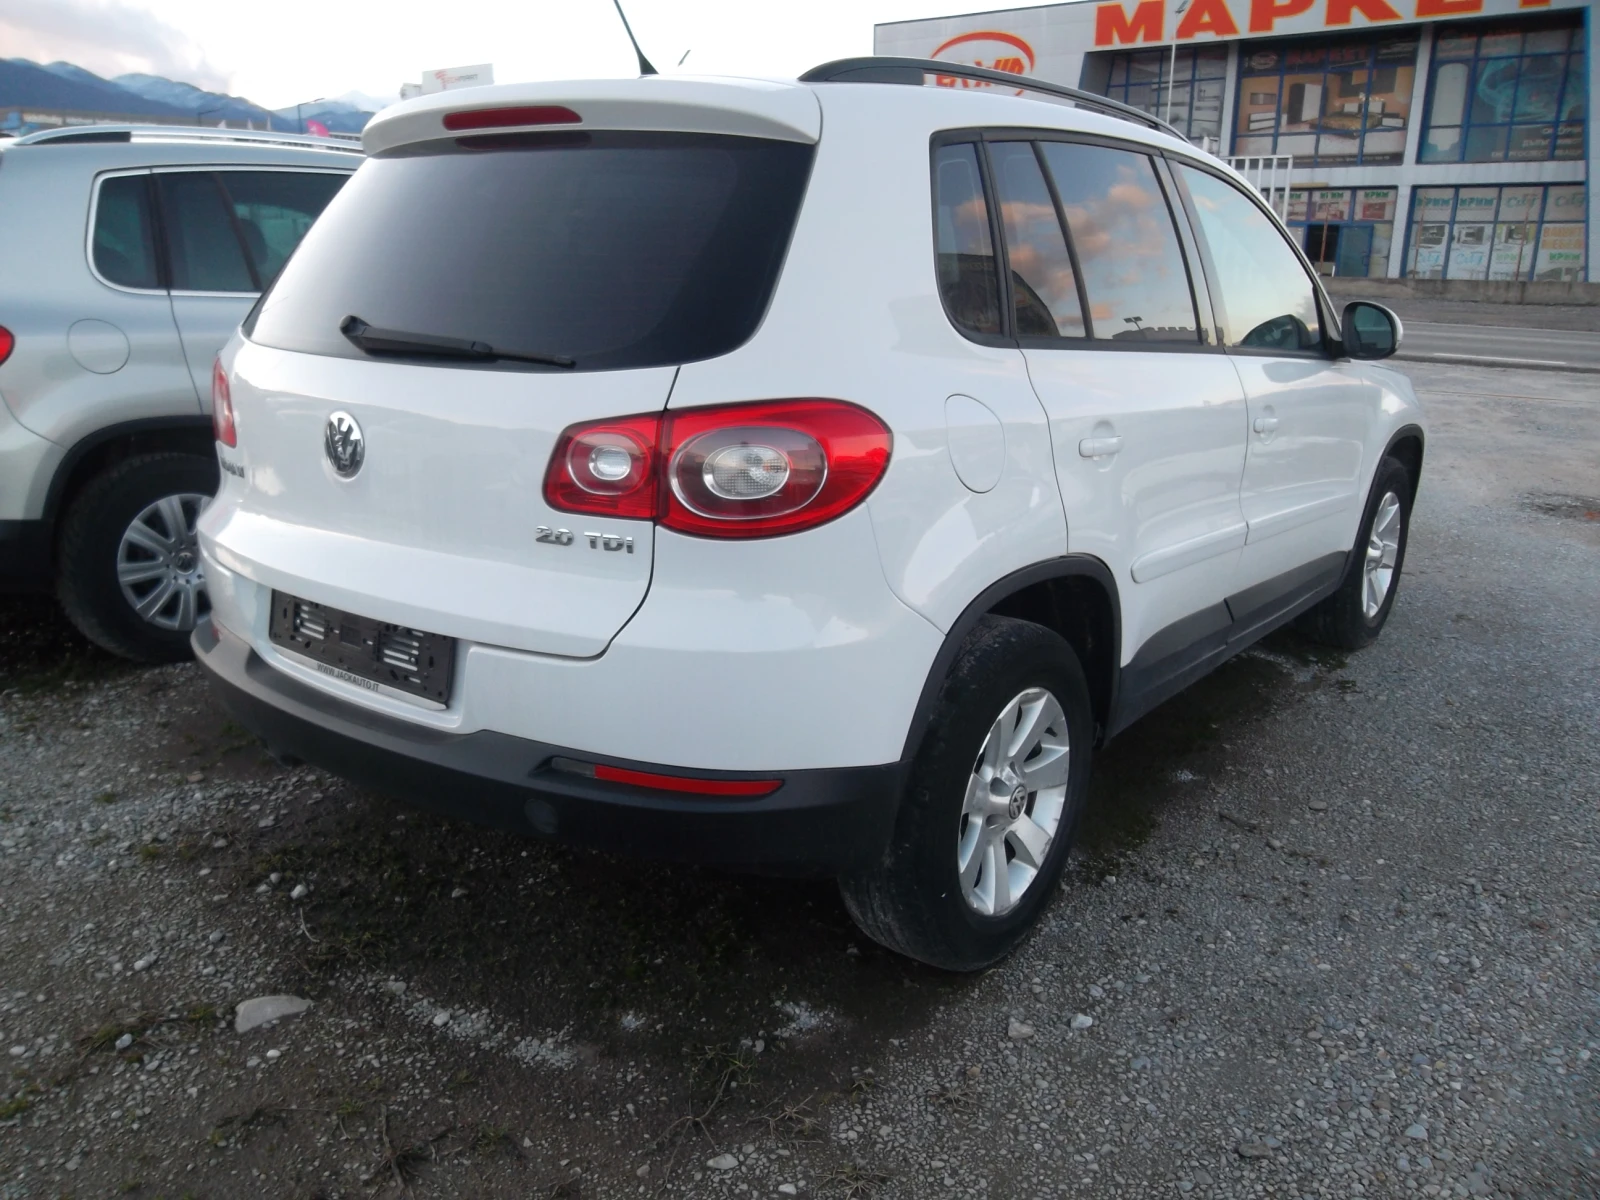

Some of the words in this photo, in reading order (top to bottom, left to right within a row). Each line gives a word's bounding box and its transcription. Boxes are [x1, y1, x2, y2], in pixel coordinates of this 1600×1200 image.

[1094, 0, 1551, 47] МАРК
[584, 531, 634, 554] TDI
[316, 662, 380, 693] WWW.JACKAUTO.IT
